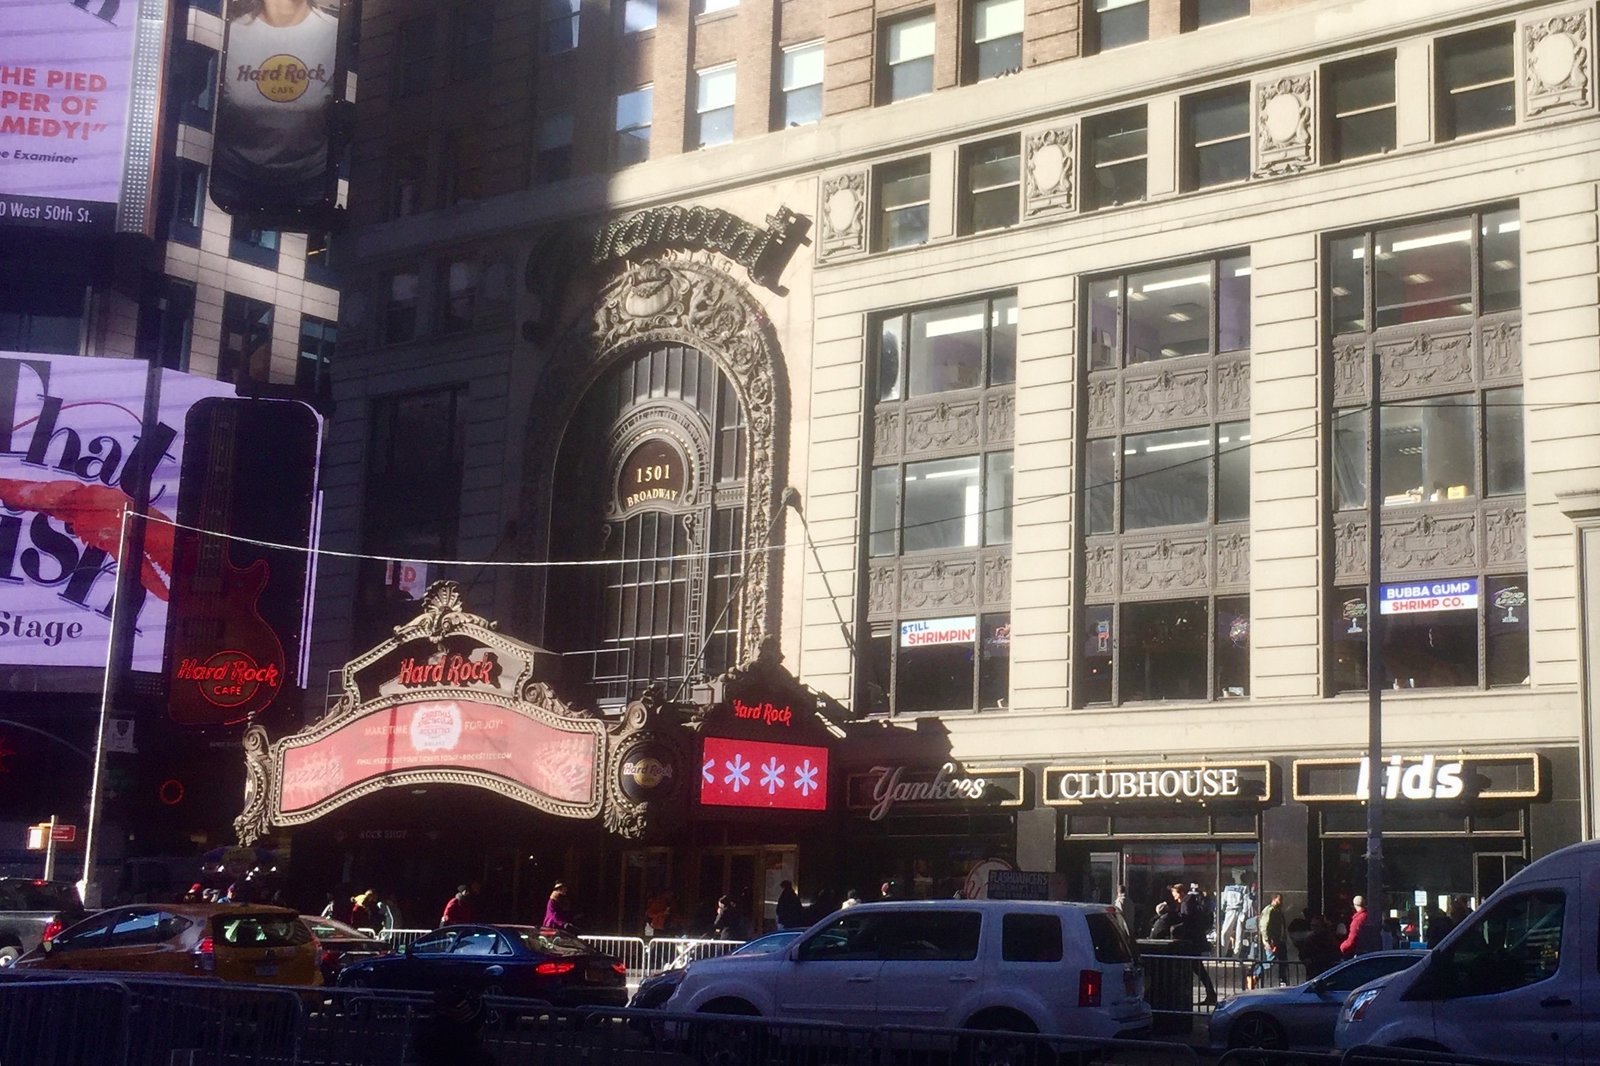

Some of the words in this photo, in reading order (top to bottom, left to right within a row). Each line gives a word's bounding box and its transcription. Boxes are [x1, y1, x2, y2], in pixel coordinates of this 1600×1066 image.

[0, 66, 36, 87] HE
[47, 70, 107, 92] PIED
[236, 64, 282, 82] Hard
[284, 64, 326, 84] Rock
[61, 96, 98, 116] OF
[14, 149, 78, 164] Examiner
[10, 202, 40, 219] West
[44, 205, 73, 221] 50th
[77, 207, 92, 223] St.
[636, 464, 670, 483] 1501
[626, 488, 678, 507] BROADWAY
[1386, 585, 1430, 600] BUBBA
[1432, 582, 1470, 596] GUMP
[1392, 598, 1439, 612] SHRIMP
[1442, 597, 1464, 609] CO.
[902, 621, 930, 634] STILL
[908, 628, 976, 645] SHRIMPIN'
[177, 659, 230, 680] Hard
[231, 660, 279, 687] Rock
[398, 655, 447, 684] Hard
[446, 652, 493, 687] Rock
[213, 685, 242, 695] CAFE
[762, 703, 792, 727] Rock
[364, 726, 387, 737] MAKE
[464, 720, 483, 730] FOR
[869, 762, 985, 821] Yankees
[1060, 769, 1239, 799] CLUBHOUSE
